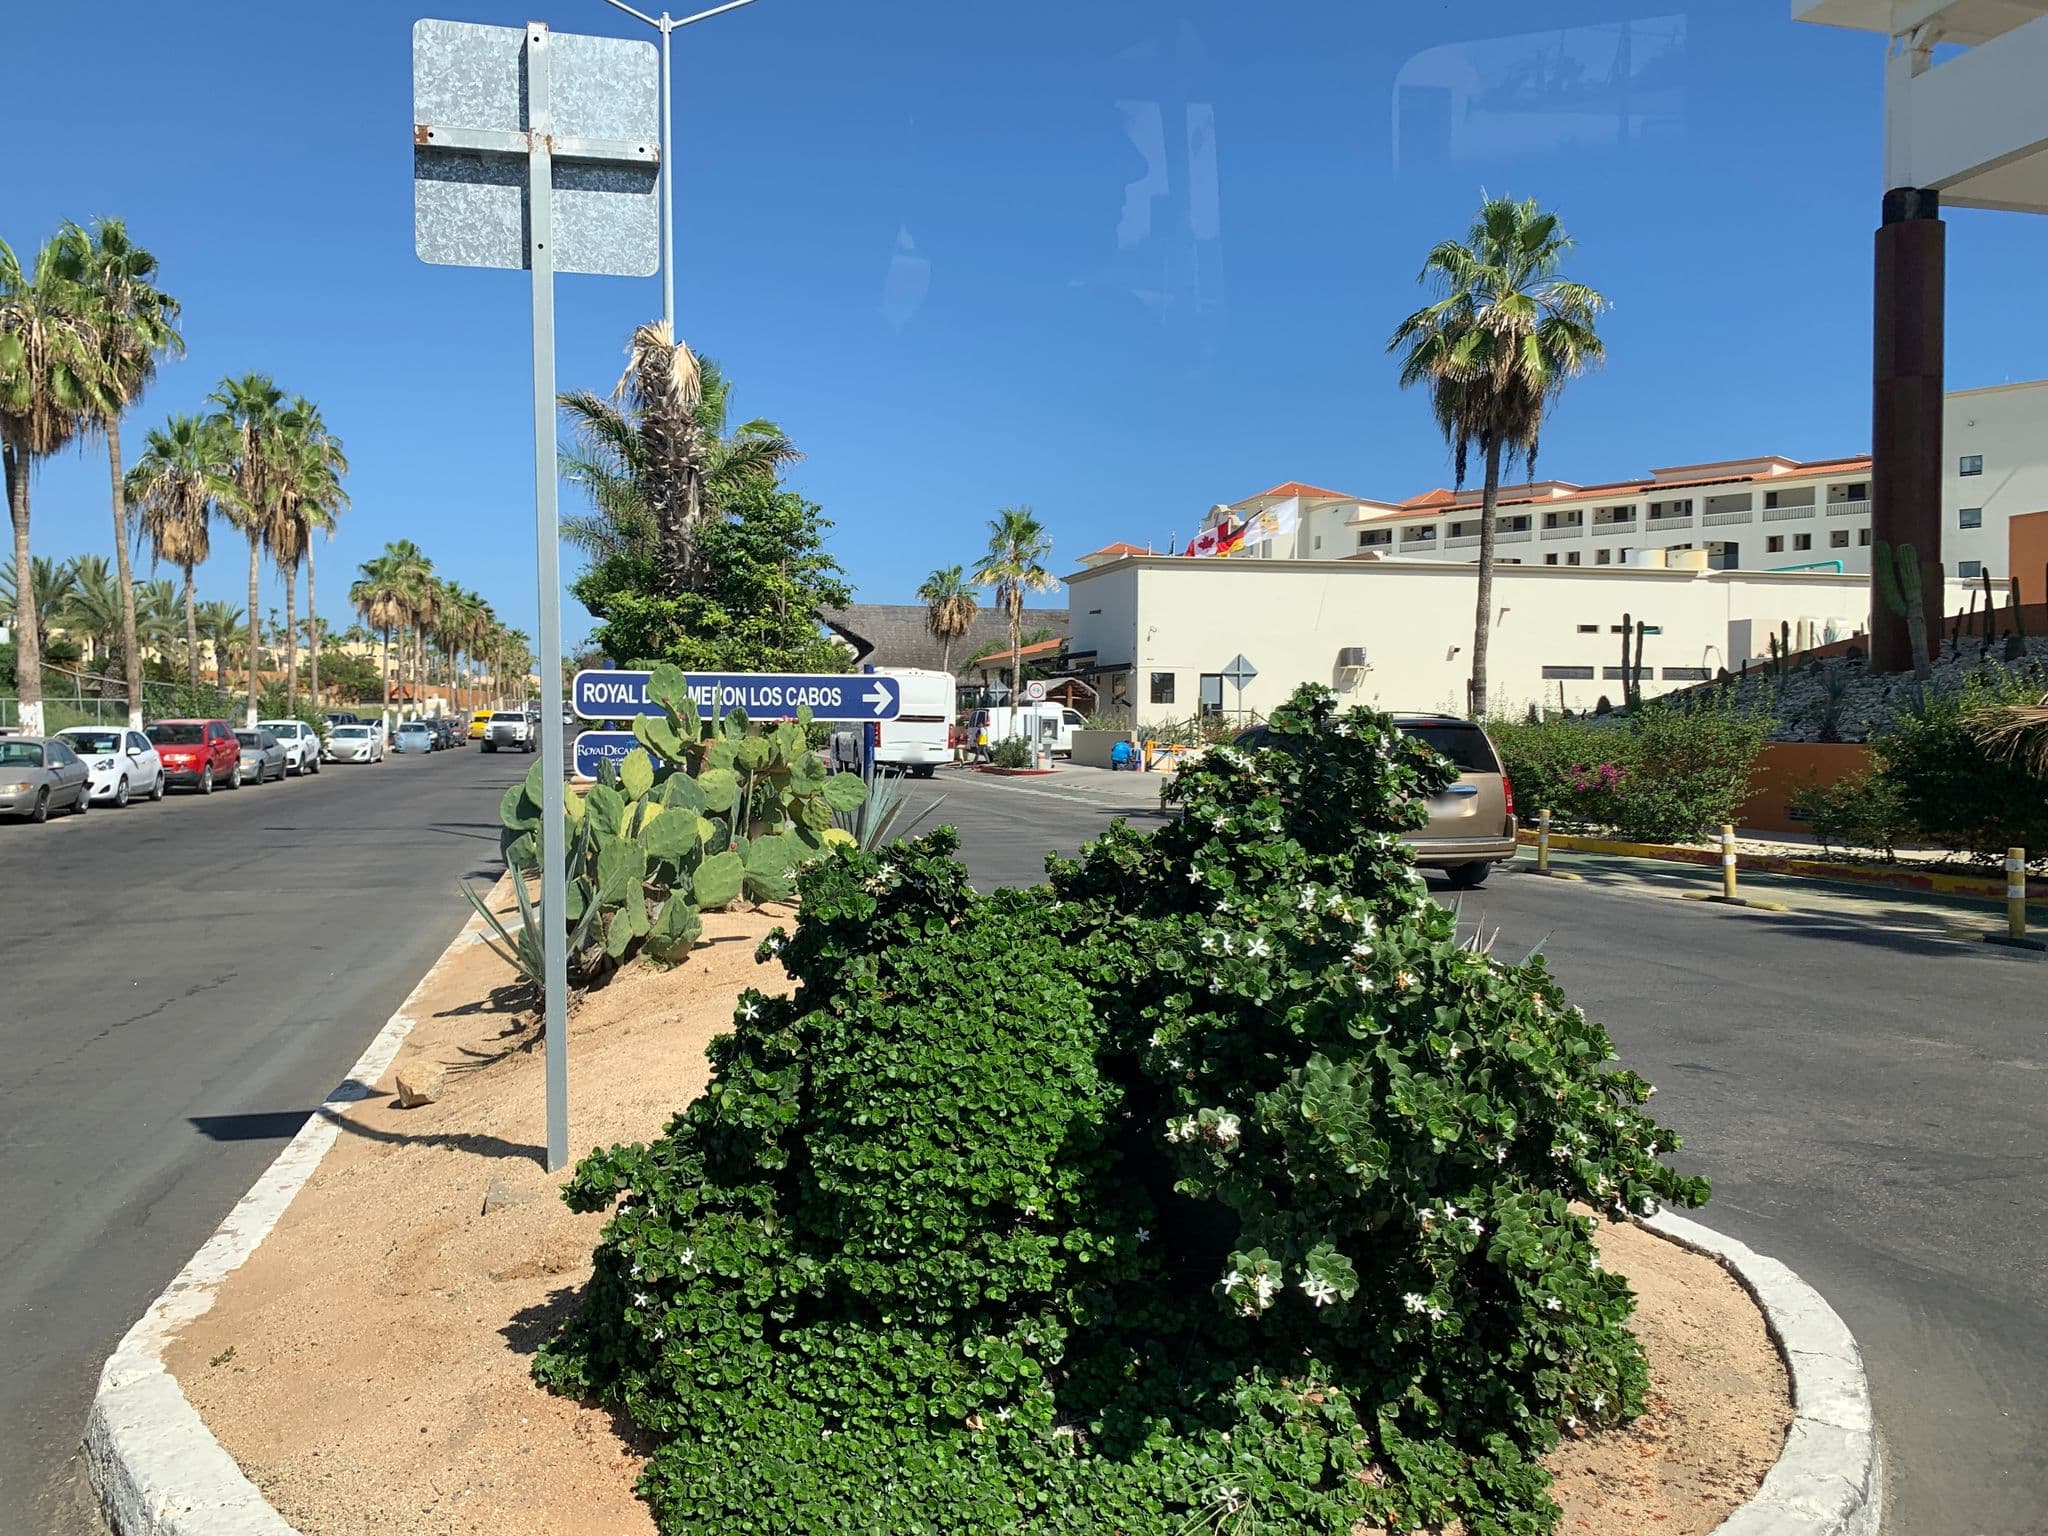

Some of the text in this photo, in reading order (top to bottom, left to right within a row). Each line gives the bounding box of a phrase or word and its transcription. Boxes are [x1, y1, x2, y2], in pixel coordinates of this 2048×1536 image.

[583, 682, 842, 708] ROYAL MERON LOS CABOS
